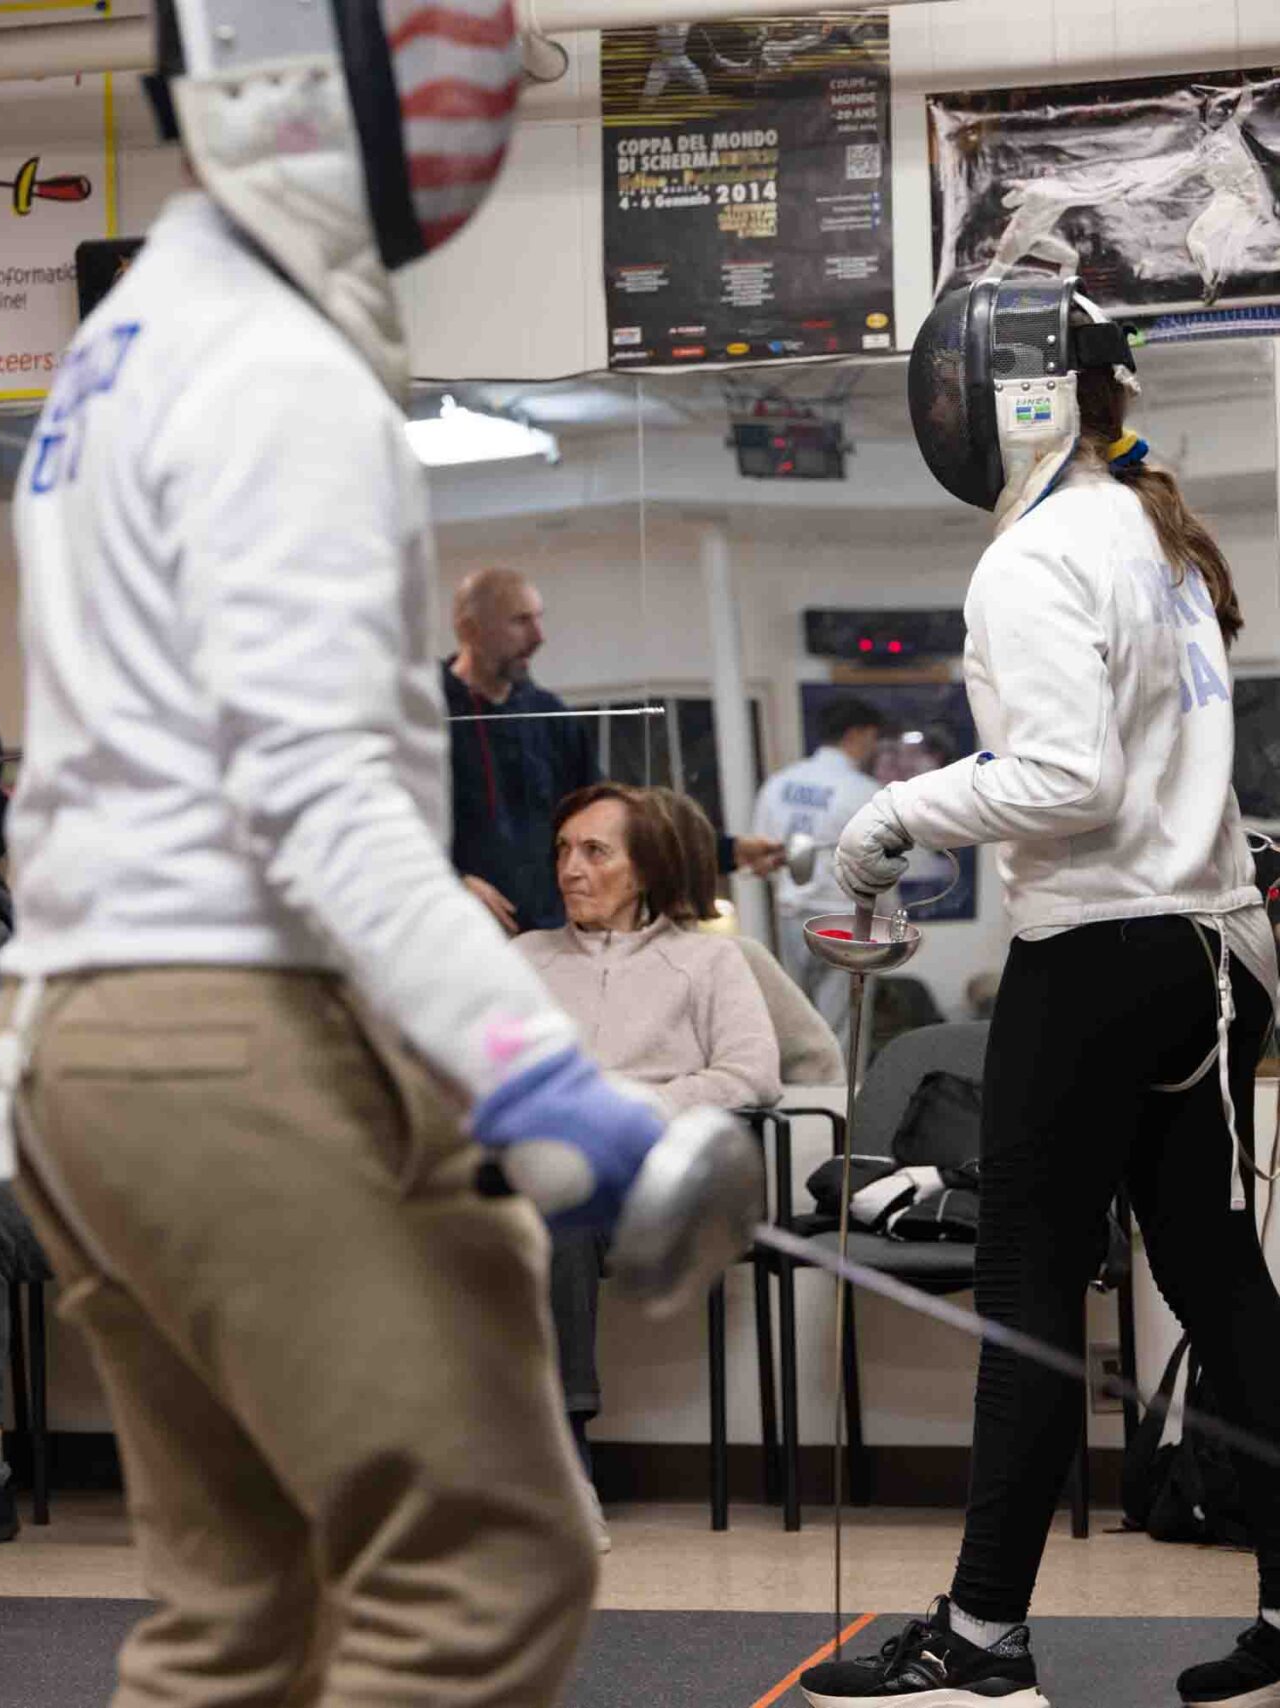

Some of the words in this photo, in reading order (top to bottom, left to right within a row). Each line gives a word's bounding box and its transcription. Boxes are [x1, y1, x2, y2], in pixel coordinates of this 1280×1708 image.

[831, 92, 877, 105] MONDE
[618, 137, 673, 155] COPPA
[677, 133, 708, 151] DEL
[712, 130, 778, 149] MONDO
[618, 157, 636, 174] DI
[640, 151, 720, 171] SCHERMA
[619, 197, 629, 210] 4
[641, 197, 650, 209] 6
[716, 181, 778, 204] 2014
